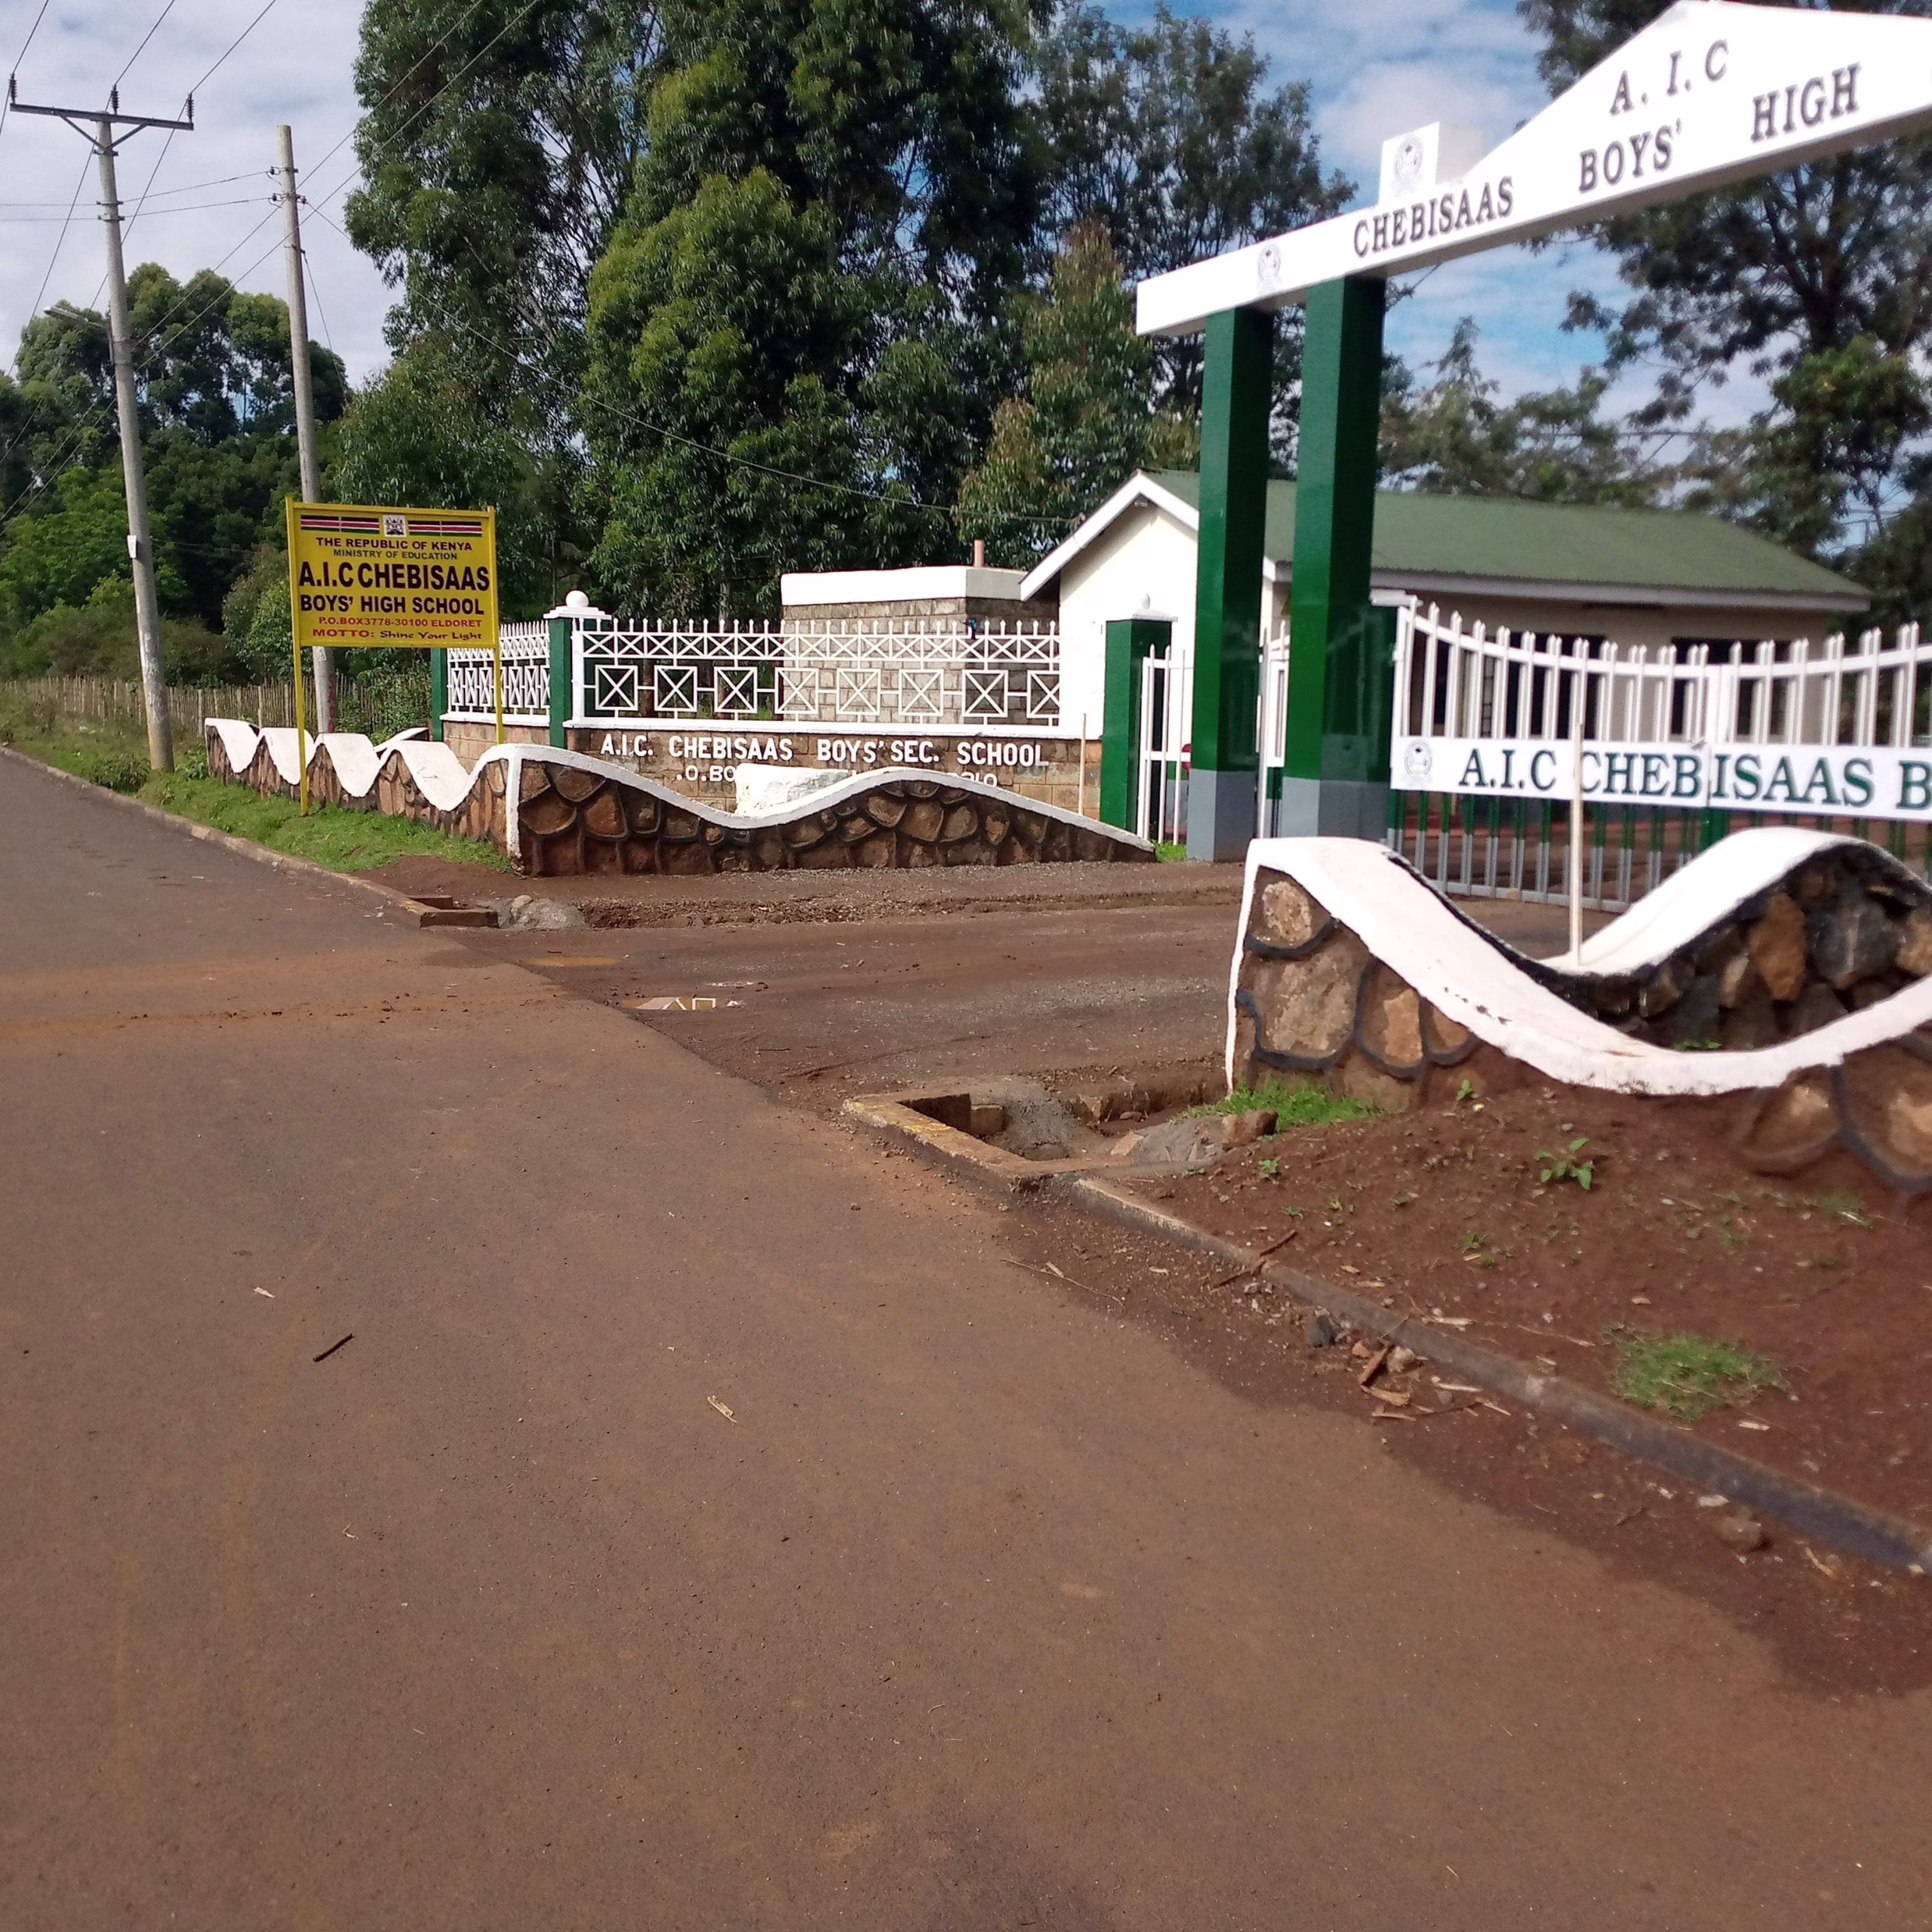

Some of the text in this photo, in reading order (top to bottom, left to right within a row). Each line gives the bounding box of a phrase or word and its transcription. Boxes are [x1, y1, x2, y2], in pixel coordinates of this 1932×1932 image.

[1353, 63, 1861, 258] CHEBISAAS BOYS' HIGH
[316, 537, 472, 551] THE REPUBLIC OF KENYA
[334, 549, 382, 558] MINISTRY
[401, 552, 457, 560] EDUCATION
[299, 561, 490, 591] A.I.C CHEBISAAS
[300, 594, 485, 615] BOYS' HIGH SCHOOL
[312, 629, 374, 638] MOTTO:
[452, 632, 482, 641] Light
[600, 733, 1050, 767] A.I.C. CHEBISAAS BOYS' SEC. SCHOOL
[1458, 748, 1557, 791] A.I.C
[1580, 750, 1875, 808] CHEBISAAS
